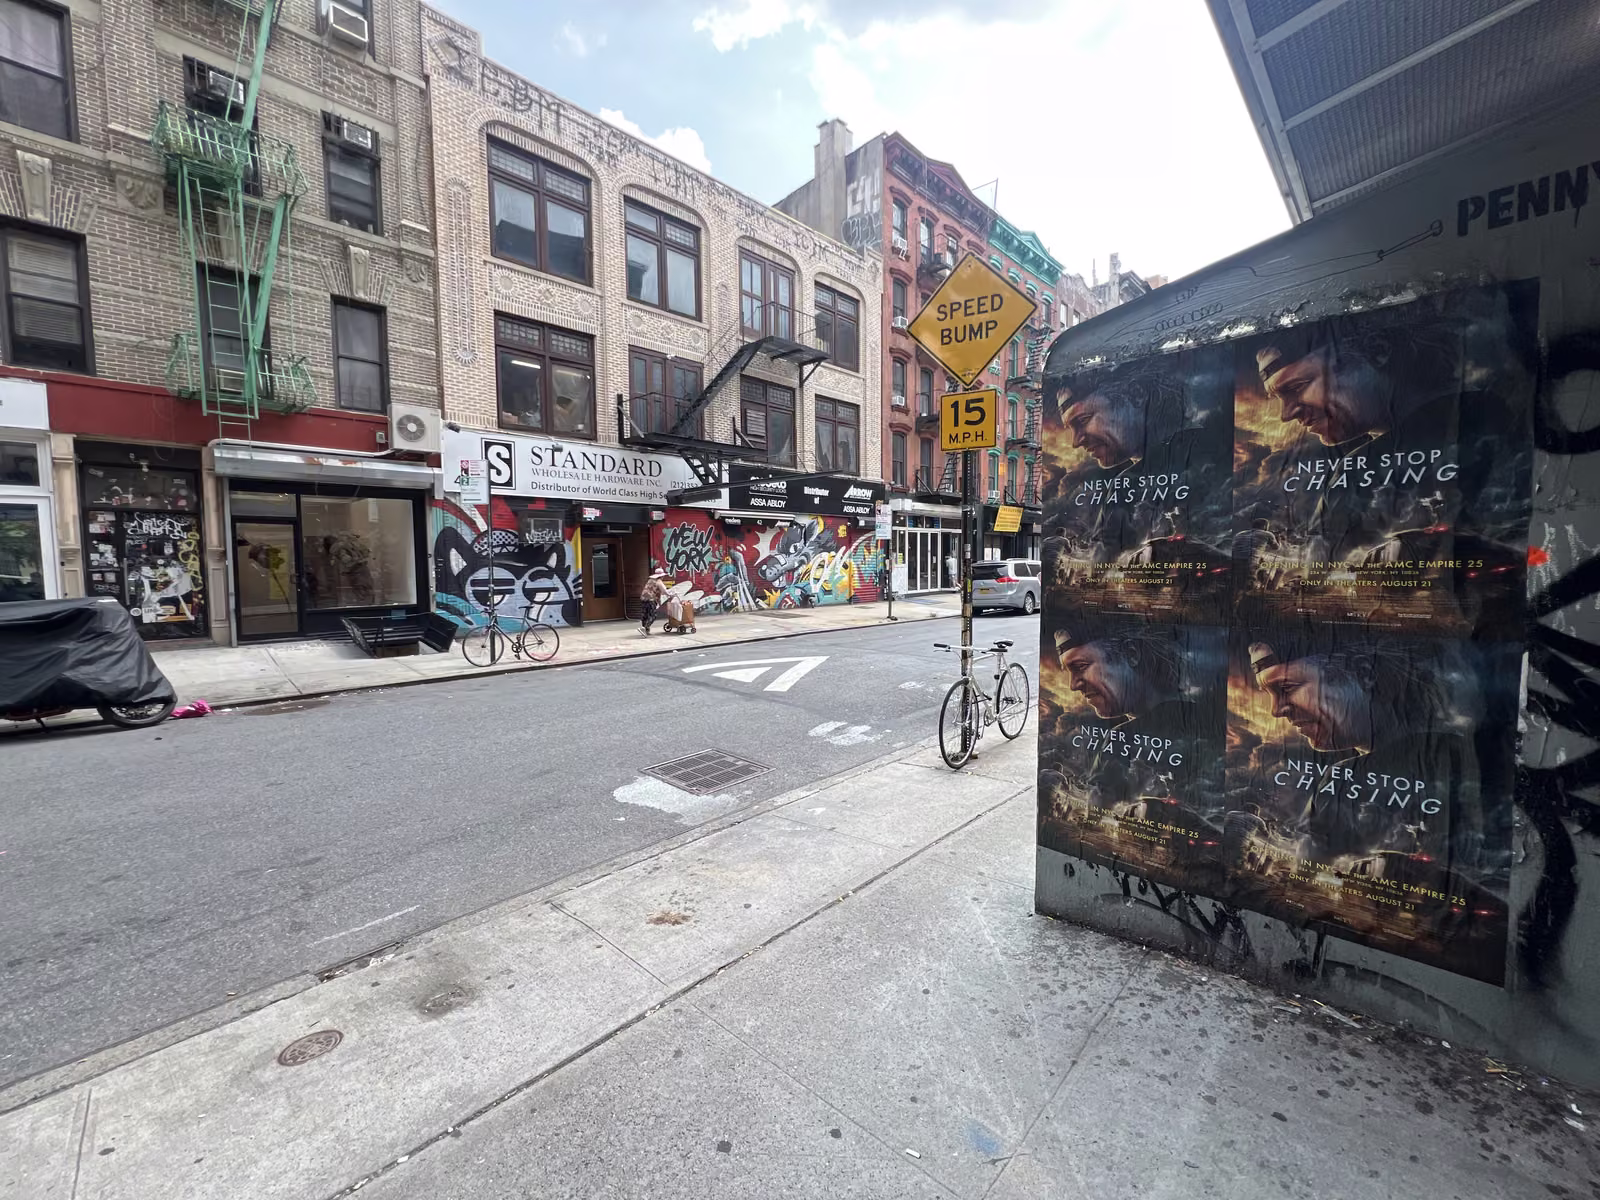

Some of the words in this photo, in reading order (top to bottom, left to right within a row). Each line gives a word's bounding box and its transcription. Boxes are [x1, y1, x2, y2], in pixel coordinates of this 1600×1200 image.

[936, 293, 1004, 322] SPEED
[940, 319, 998, 346] BUMP
[950, 398, 986, 428] 15
[949, 430, 987, 444] M.P.H.
[487, 444, 511, 484] S
[530, 445, 662, 478] STANDARD
[1298, 456, 1367, 474] NEVER
[1380, 450, 1441, 467] STOP
[531, 467, 592, 481] WHOLESALE
[594, 473, 644, 486] HARDWARE
[646, 480, 662, 488] INC.
[531, 481, 580, 493] Distributor
[582, 486, 591, 494] of
[592, 486, 617, 496] World
[618, 488, 638, 497] Class
[640, 490, 657, 500] High
[1084, 477, 1130, 491] NEVER
[1138, 473, 1178, 487] STOP
[1283, 463, 1460, 492] CHASING
[750, 497, 767, 507] ASSA
[767, 499, 786, 508] ABLOY
[1074, 485, 1190, 506] CHASING
[667, 521, 715, 549] NEW
[665, 546, 713, 577] YORK
[1385, 560, 1414, 568] AMC
[1418, 560, 1462, 568] EMPIRE
[1467, 560, 1484, 568] 25
[1072, 735, 1183, 766] CHASING
[1081, 725, 1126, 742] NEVER
[1133, 734, 1172, 750] STOP
[1287, 758, 1354, 781] NEVER
[1366, 772, 1425, 793] STOP
[1274, 771, 1442, 814] CHASING
[1137, 817, 1155, 827] AMC
[1157, 822, 1186, 835] EMPIRE
[1188, 830, 1199, 839] 25
[1288, 872, 1310, 883] ONLY
[1365, 893, 1402, 907] AUGUST
[1405, 902, 1415, 911] 21
[1301, 859, 1312, 867] IN
[1371, 875, 1398, 888] AMC
[1402, 883, 1446, 900] EMPIRE
[1451, 895, 1466, 906] 25
